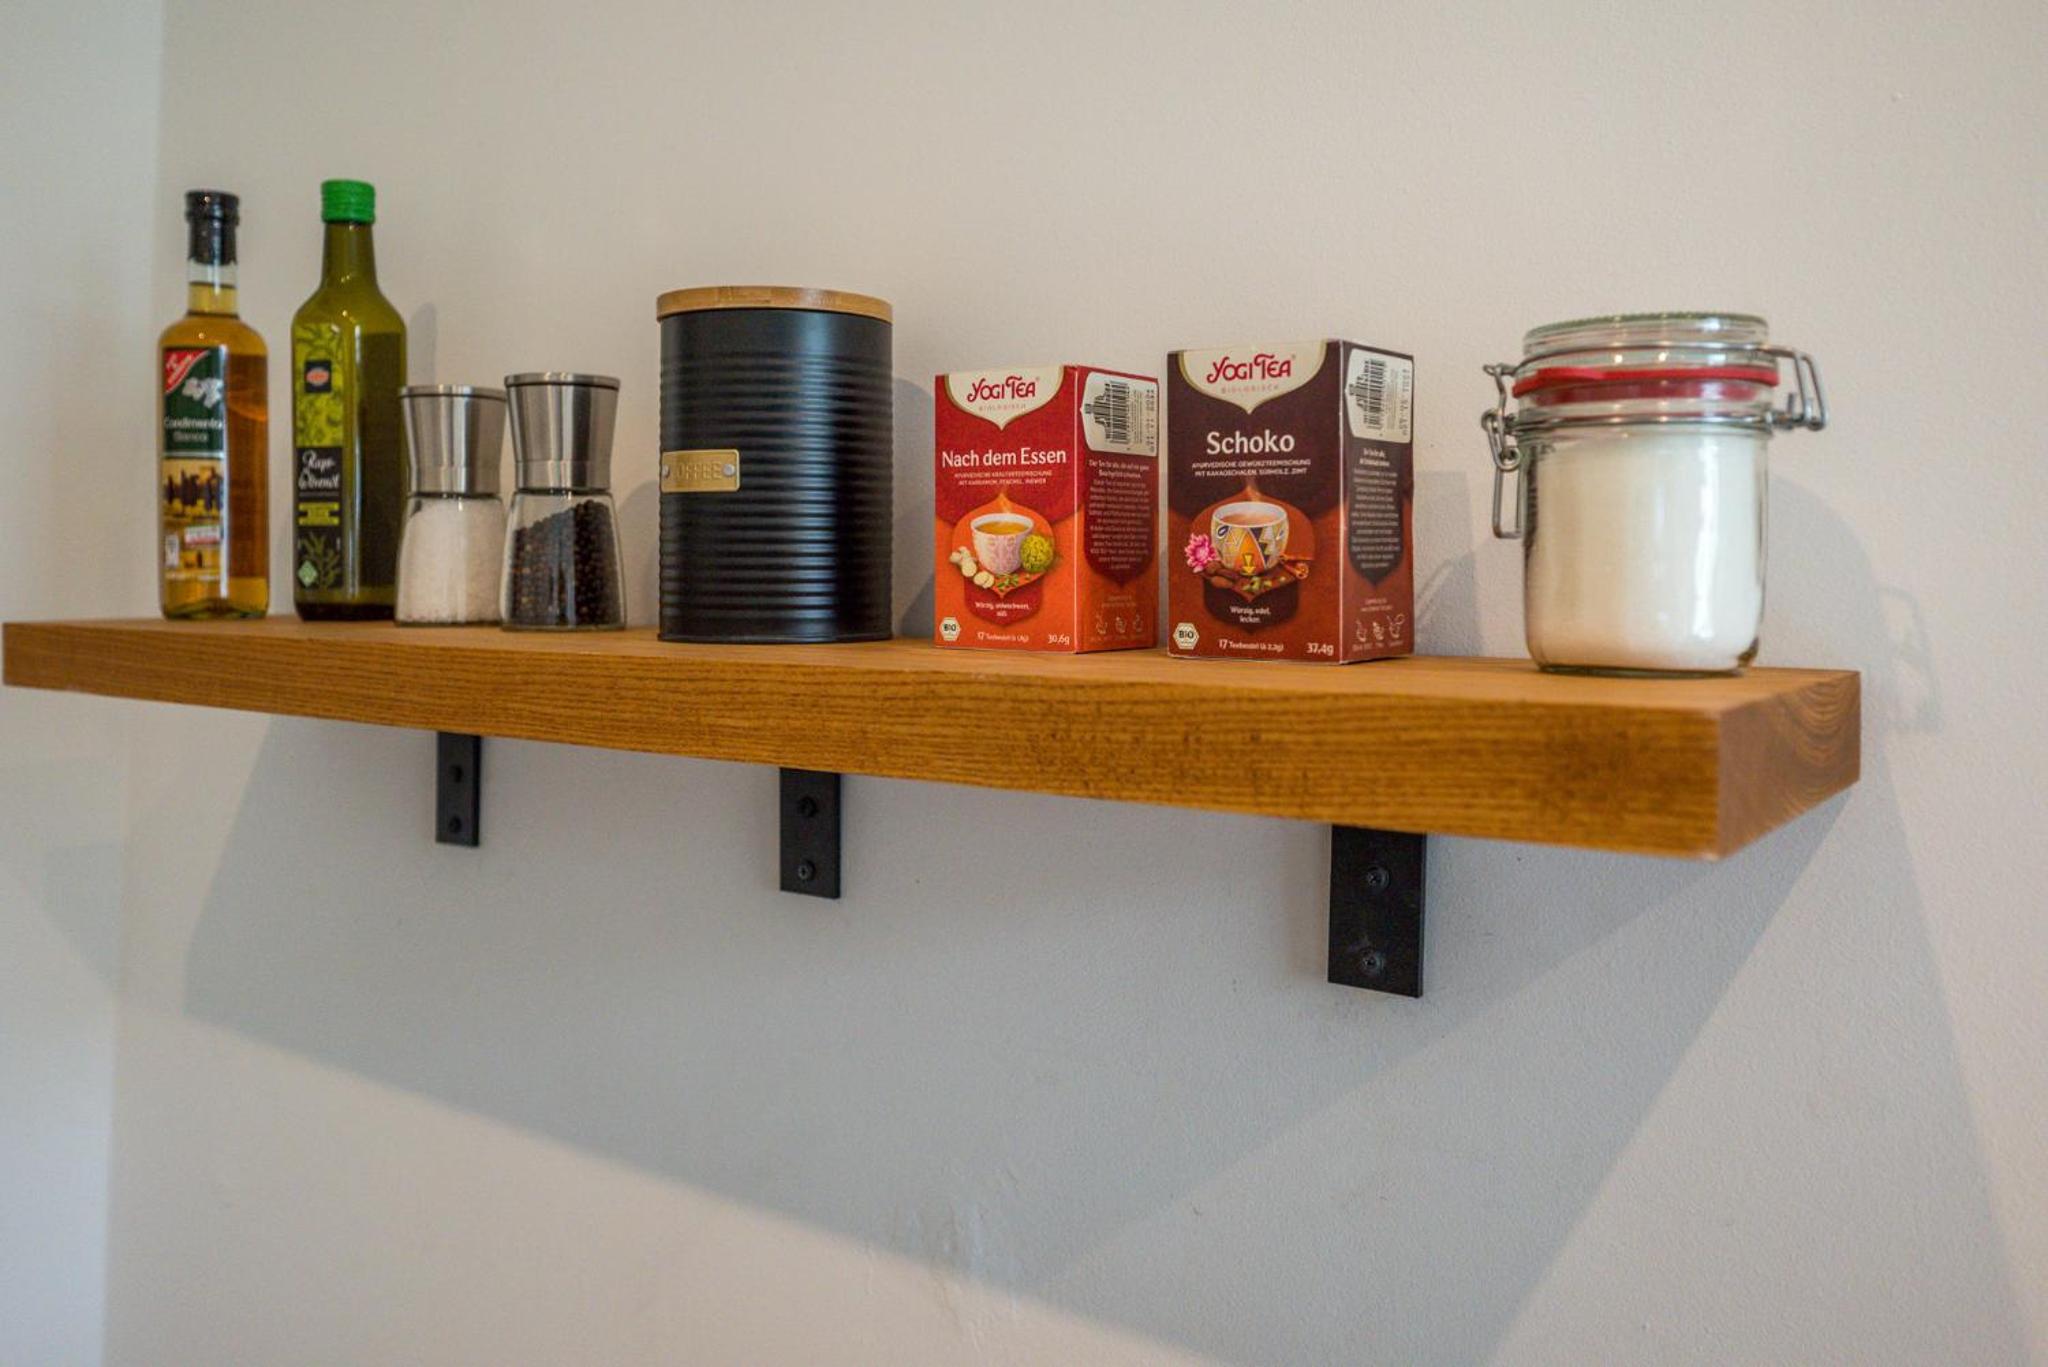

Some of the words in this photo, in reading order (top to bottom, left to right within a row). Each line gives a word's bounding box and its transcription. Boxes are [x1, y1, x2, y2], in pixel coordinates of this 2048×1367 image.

[1206, 429, 1295, 455] Schoko
[942, 450, 980, 468] Nach
[983, 449, 1017, 466] dem
[1020, 447, 1067, 465] Essen
[671, 461, 722, 481] OFFEE
[1178, 630, 1194, 640] BIO
